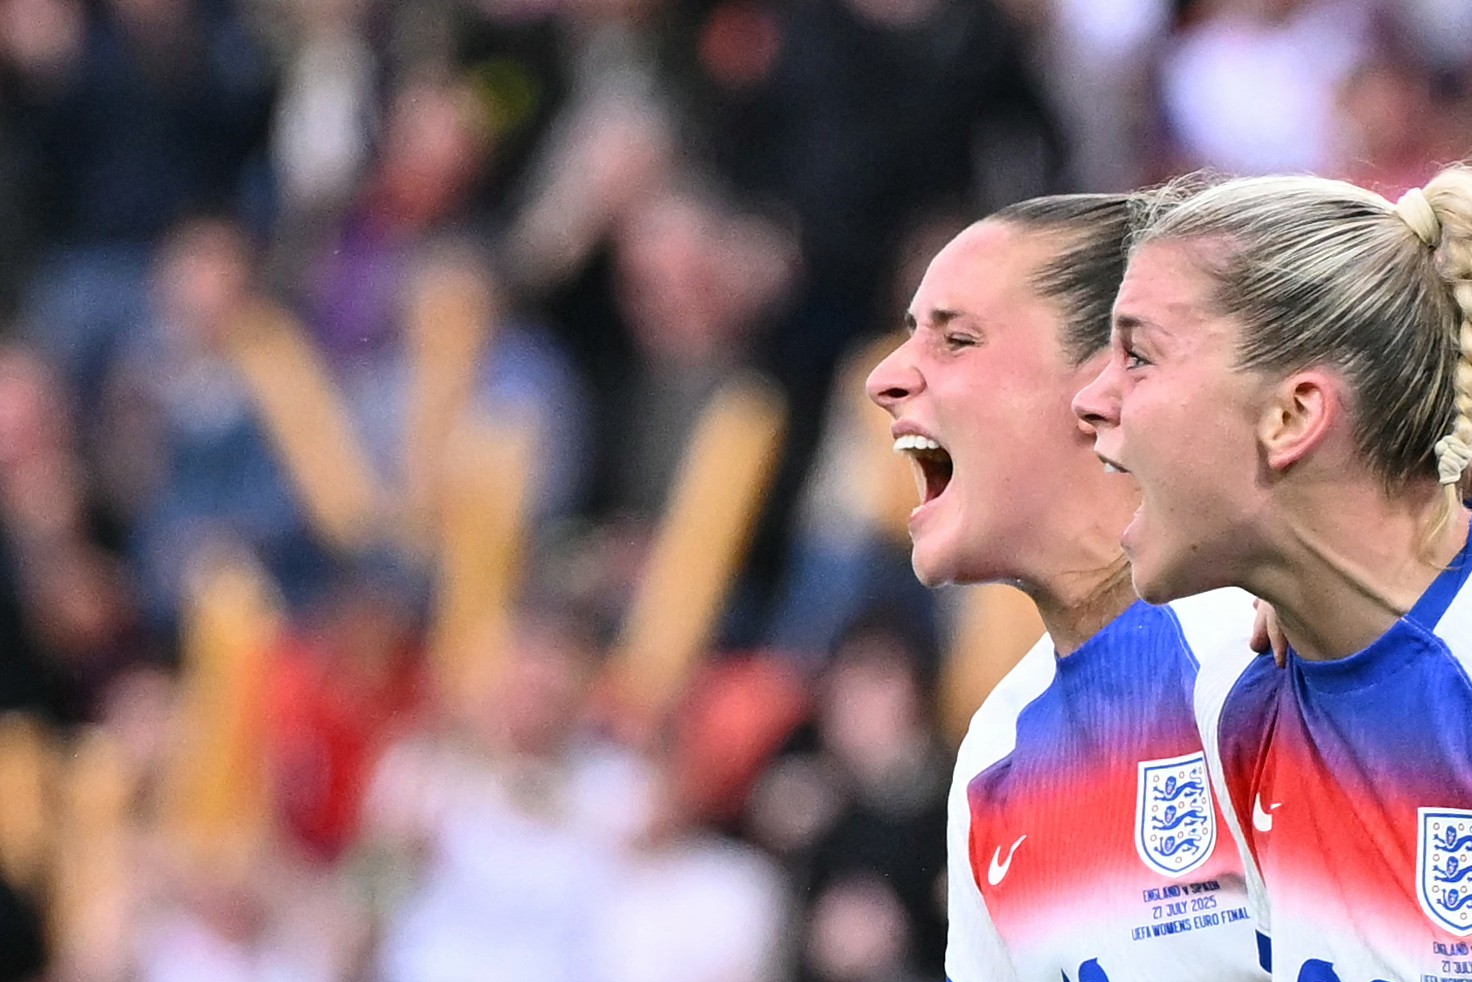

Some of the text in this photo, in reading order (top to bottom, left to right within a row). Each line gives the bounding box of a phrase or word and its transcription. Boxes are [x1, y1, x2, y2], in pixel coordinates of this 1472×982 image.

[1143, 885, 1181, 902] ENGLAND
[1190, 880, 1220, 894] SPAIN
[1152, 896, 1217, 919] 27 JULY 2025
[1131, 907, 1250, 941] UEFA WOMENS EURO FINAL
[1433, 942, 1469, 956] ENGLAND
[1442, 960, 1451, 973] 27
